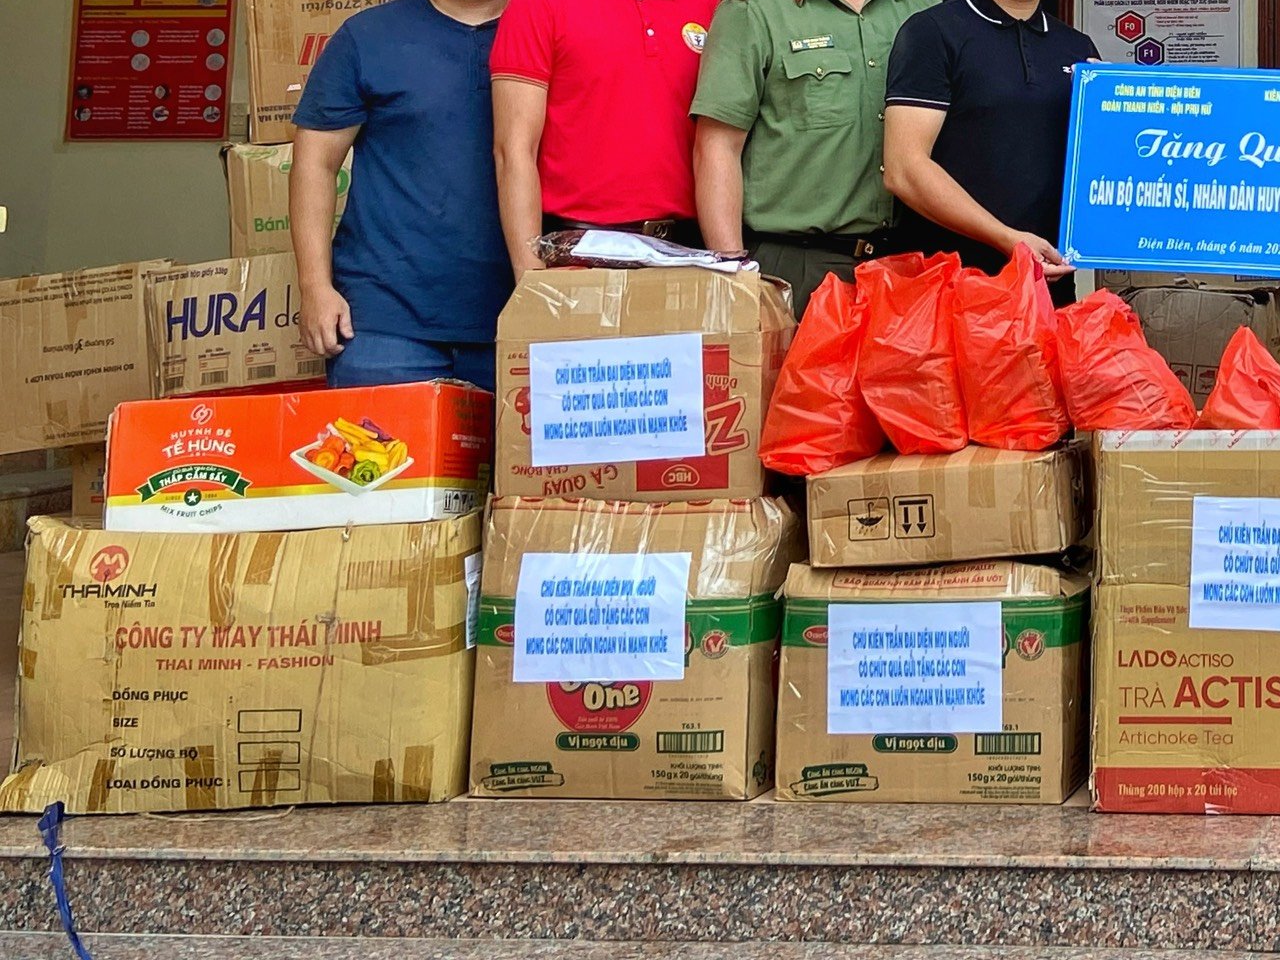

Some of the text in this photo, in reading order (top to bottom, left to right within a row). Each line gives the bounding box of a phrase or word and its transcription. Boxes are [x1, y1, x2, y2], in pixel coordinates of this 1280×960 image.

[1124, 22, 1136, 30] F0
[1143, 49, 1154, 58] F1
[1114, 83, 1134, 97] CÔNG
[1135, 85, 1147, 97] AN
[1183, 86, 1201, 99] BIÊN
[1122, 101, 1147, 113] THANH
[1147, 101, 1165, 114] NIÊN
[1171, 102, 1184, 117] HỘI
[1184, 103, 1200, 117] PHỤ
[1200, 101, 1213, 117] NỮ
[1134, 128, 1228, 167] Tặng
[1089, 175, 1114, 207] CÁN
[1115, 176, 1133, 213] BỘ
[1135, 173, 1172, 209] CHIẾN
[1173, 178, 1190, 213] SĨ,
[1192, 180, 1227, 212] NHÂN
[1228, 181, 1255, 215] DÂN
[1137, 237, 1163, 252] Điện
[1165, 238, 1194, 253] Biên,
[1196, 239, 1226, 256] tháng
[1228, 240, 1237, 254] 6
[1238, 242, 1264, 255] năm
[166, 287, 268, 343] HURA
[161, 438, 185, 459] TẾ
[542, 465, 619, 496] GÀ QUAY
[667, 471, 692, 483] HBC
[160, 503, 223, 518] MIX FRUIT CHIPS
[115, 618, 383, 651] CÔNG TY MAY THÁI MINH
[156, 655, 335, 671] THAI MINH FASHION
[153, 690, 188, 704] PHỤC
[583, 682, 641, 711] One
[1118, 682, 1166, 709] TRÀ
[112, 717, 139, 728] SIZE
[567, 735, 628, 750] Vị ngọt dịu
[885, 737, 946, 751] Vị ngọt dịu
[1118, 729, 1234, 745] Artichoke Tea
[110, 744, 198, 761] SỐ LƯỢNG BỘ
[106, 778, 136, 792] LOẠI
[186, 777, 223, 790] PHỤC
[967, 773, 989, 784] 150g
[996, 773, 1007, 782] 20
[1118, 783, 1238, 798] Thùng 200 hộp x 20 túi lọc
